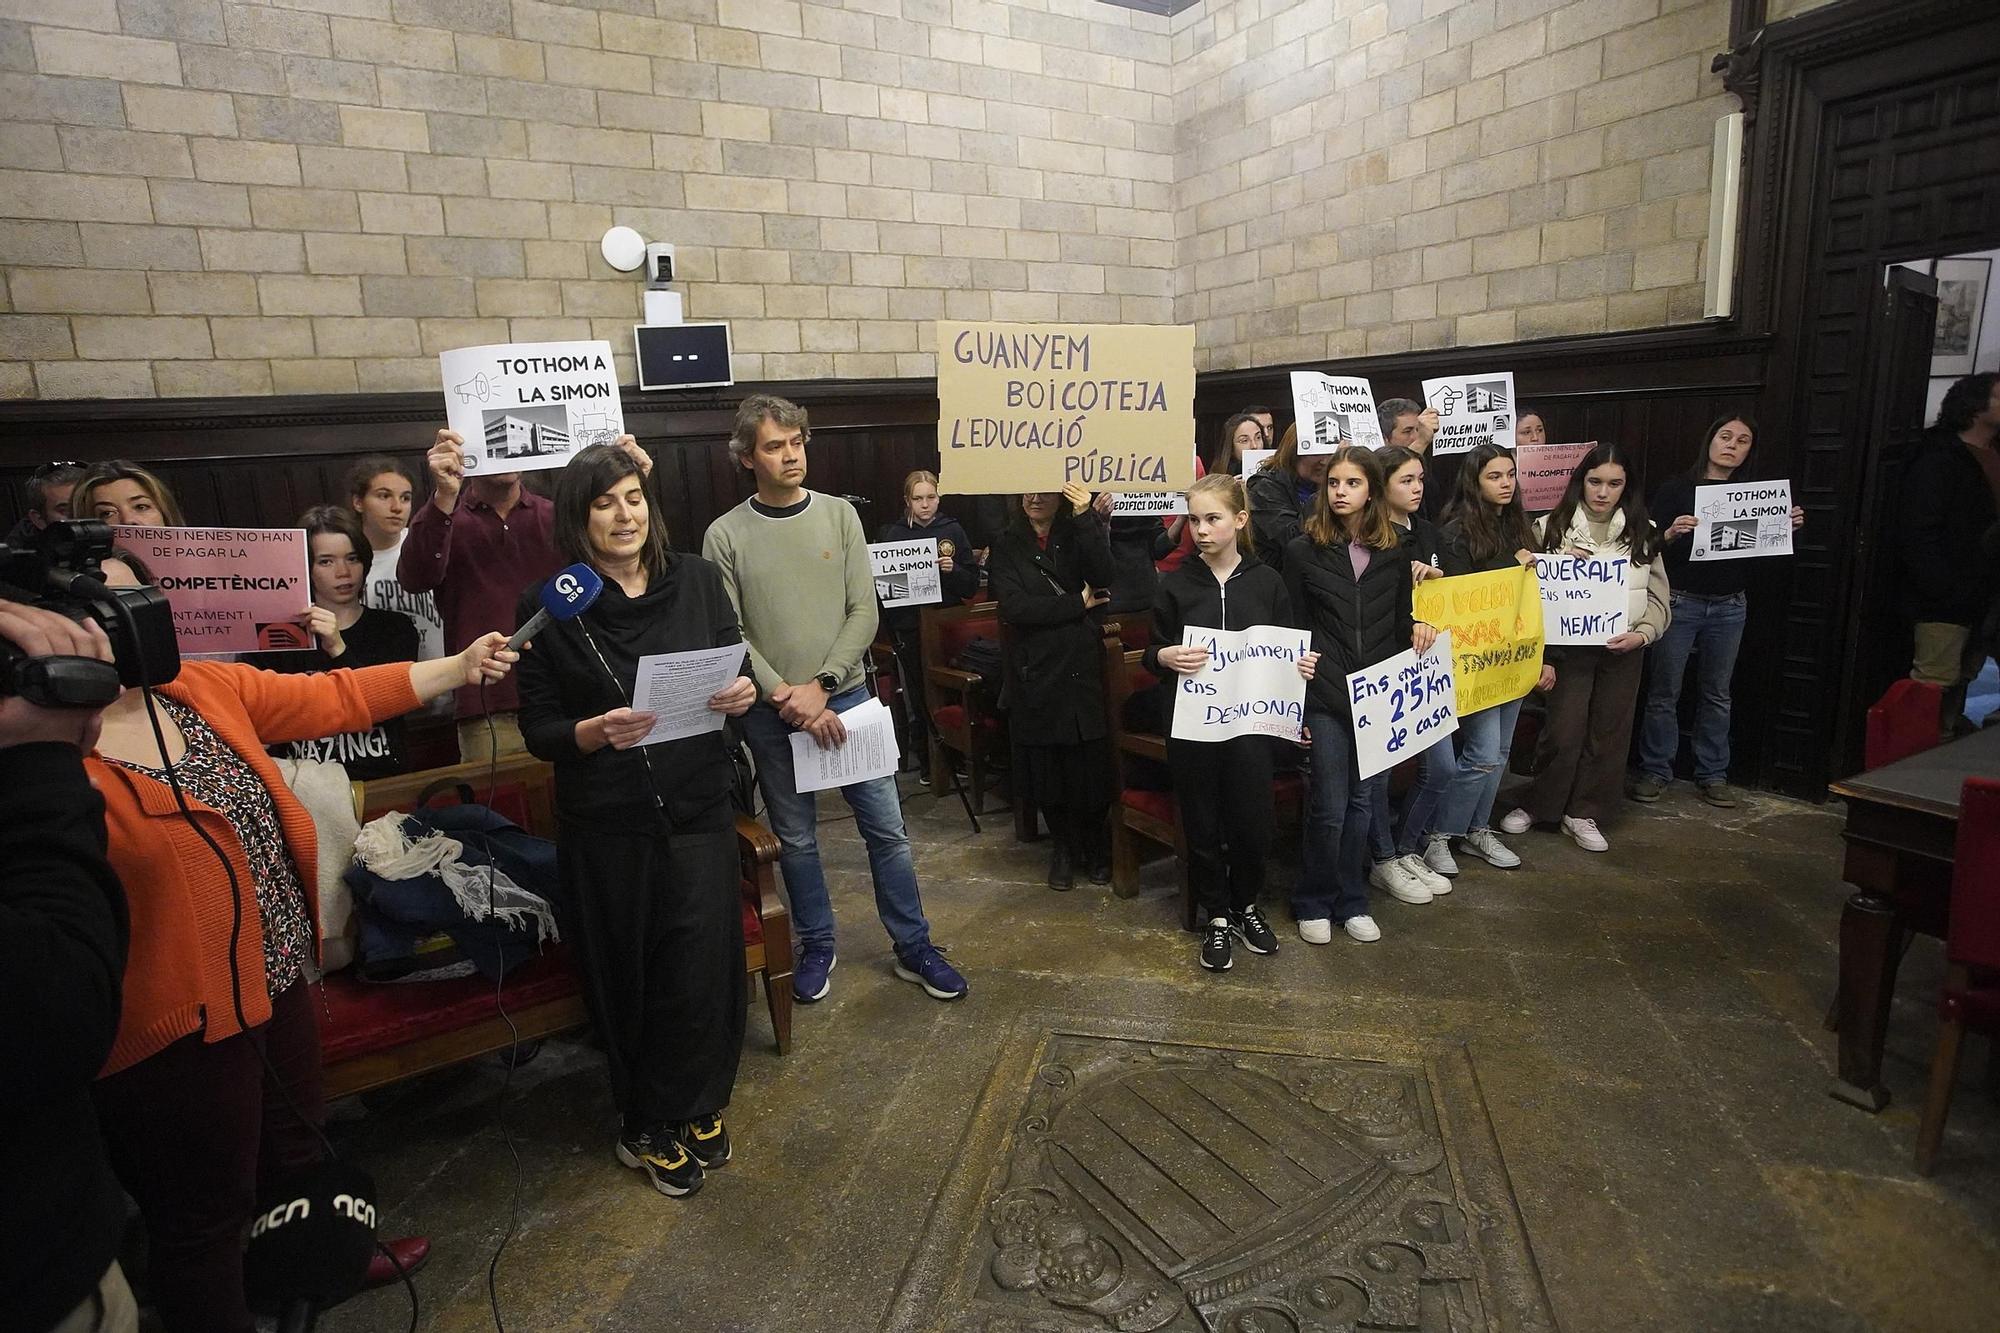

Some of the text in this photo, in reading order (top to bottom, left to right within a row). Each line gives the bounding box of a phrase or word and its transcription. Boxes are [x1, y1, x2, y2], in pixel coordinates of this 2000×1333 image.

[953, 329, 1090, 372] GUANYEM
[496, 355, 607, 376] TOTHOM A
[517, 382, 611, 403] LA SIMON
[1360, 386, 1368, 396] A
[1339, 402, 1371, 413] SIMON
[1442, 422, 1488, 436] VOLEM UN
[1726, 488, 1787, 502] TOTHOM A
[1114, 500, 1175, 511] EDIFICI DIGNE
[1733, 505, 1787, 519] LA SIMON
[135, 529, 172, 540] NENS
[176, 530, 179, 540] I
[184, 531, 233, 541] NENES
[236, 532, 258, 542] NO
[262, 532, 293, 542] HAN
[152, 546, 248, 558] DE PAGAR LA
[873, 546, 932, 559] TOTHOM A
[882, 560, 933, 573] LA SIMON
[1535, 557, 1628, 586] QUERALT,
[1565, 589, 1592, 600] HAS
[1415, 592, 1445, 622] NO
[249, 611, 253, 620] I
[1352, 674, 1389, 704] Ens
[1398, 653, 1440, 682] envieu
[1183, 678, 1217, 696] ens
[1203, 700, 1303, 725] DESNONA
[1358, 714, 1371, 729] a
[1386, 705, 1452, 753] de casa
